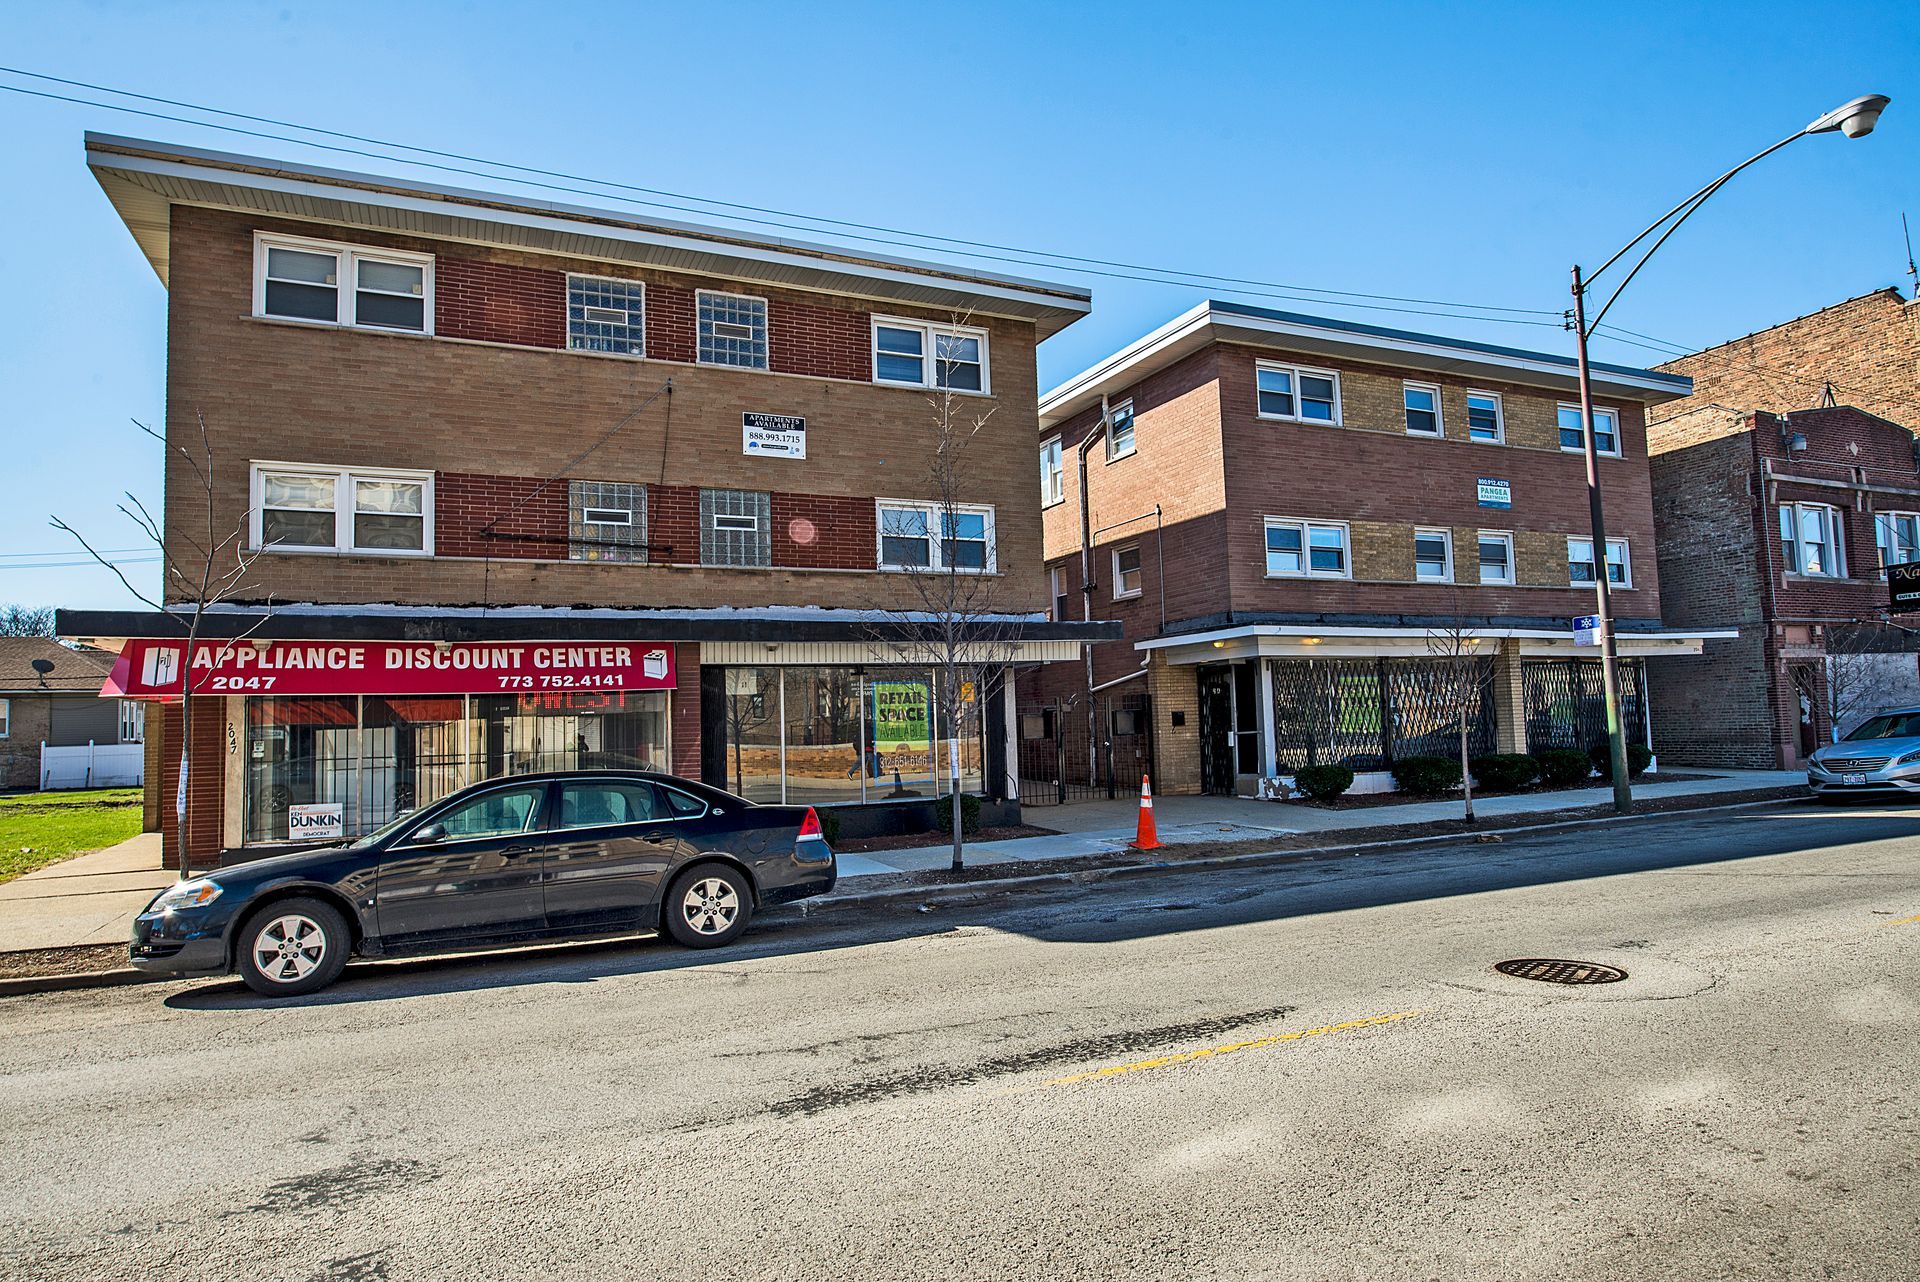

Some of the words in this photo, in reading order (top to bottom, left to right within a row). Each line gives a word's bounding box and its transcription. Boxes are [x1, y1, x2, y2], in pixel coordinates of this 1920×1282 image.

[749, 415, 800, 424] APARTMENTS
[754, 421, 796, 429] AVAILABLE
[749, 432, 800, 443] 888.993.1715
[1480, 487, 1508, 495] PANGEA
[192, 646, 365, 670] APPLIANCE
[385, 647, 525, 670] DISCOUNT
[533, 646, 632, 669] CENTER
[212, 676, 277, 690] 2047
[498, 675, 534, 688] 773
[539, 674, 624, 687] 752.4141
[879, 691, 925, 704] RETAIL
[879, 707, 925, 722] SPACE
[880, 723, 926, 739] AVAILABLE
[228, 722, 237, 755] 2047
[291, 814, 341, 827] DUNKIN
